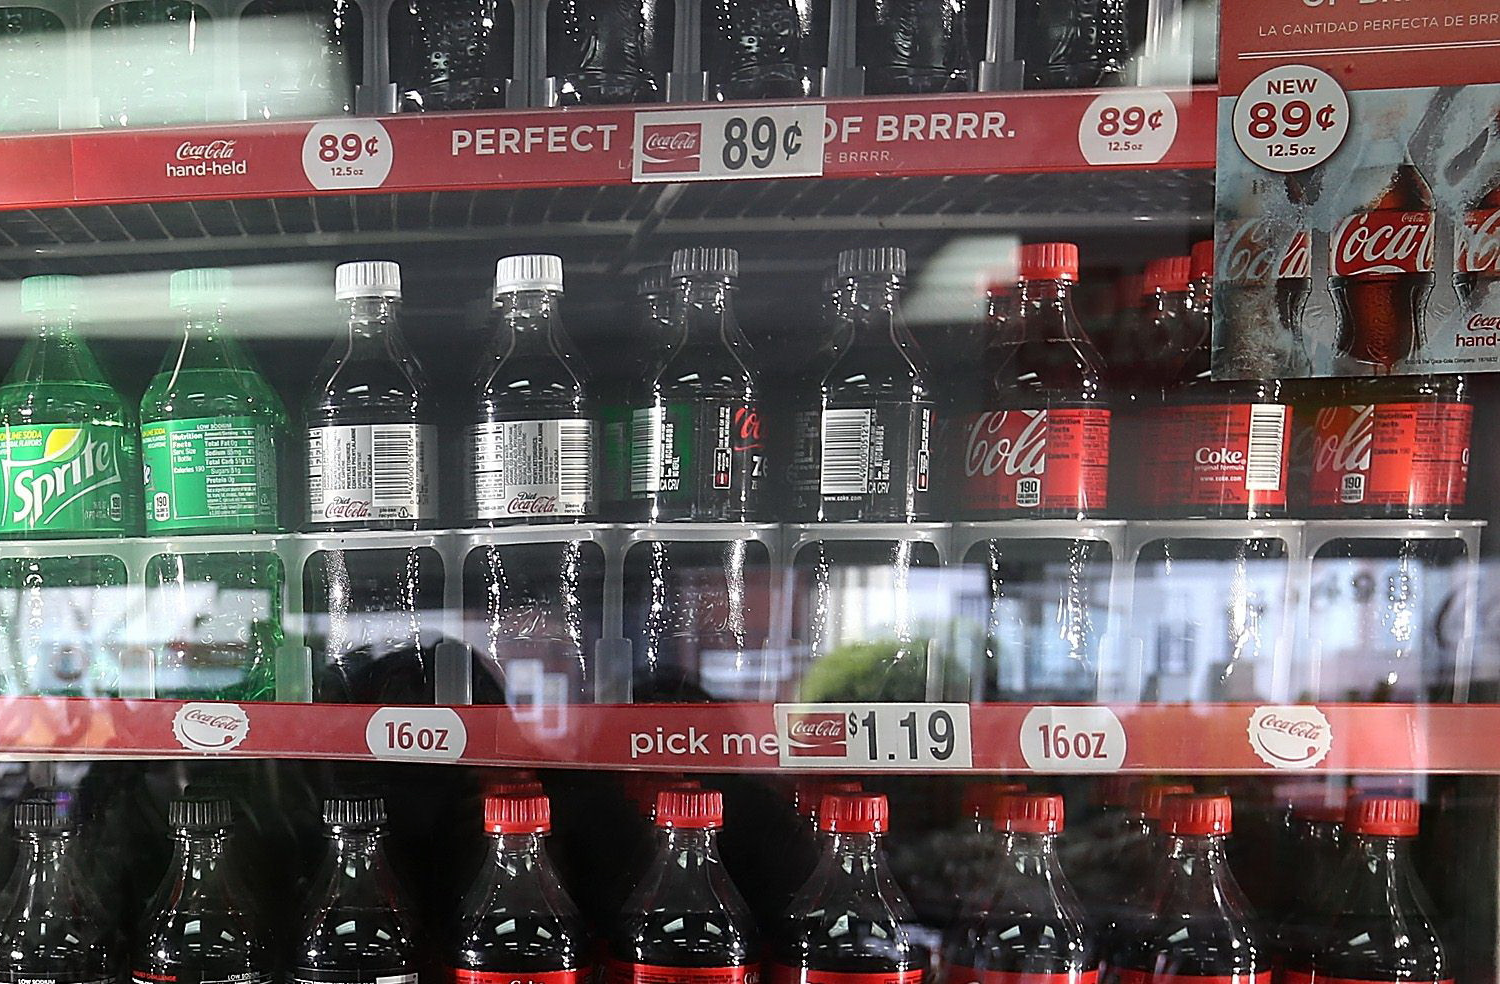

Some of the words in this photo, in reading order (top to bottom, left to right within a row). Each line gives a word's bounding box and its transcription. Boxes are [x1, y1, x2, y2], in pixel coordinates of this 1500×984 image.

[1259, 24, 1278, 37] LA
[1282, 21, 1359, 36] CANTIDAD
[1363, 17, 1439, 32] PERFECTA
[1444, 16, 1464, 27] DE
[1267, 78, 1318, 95] NEW
[1097, 106, 1164, 137] 89¢
[1248, 102, 1336, 139] 89¢
[452, 125, 618, 156] PERFECT
[876, 111, 1016, 141] BRRRR.
[722, 115, 803, 171] 89¢
[176, 139, 237, 161] Coca-Cola
[318, 133, 379, 163] 89¢
[166, 160, 247, 177] hand-held
[172, 433, 203, 441] Nutrition
[1195, 447, 1243, 464] Coke
[12, 439, 112, 528] Sprite
[1019, 481, 1038, 493] 190
[1344, 476, 1361, 489] 190
[156, 496, 168, 508] 190
[325, 501, 370, 519] Coca-Cola
[507, 496, 556, 514] Coca-Cola
[183, 708, 241, 733] Coca-Cola
[1259, 713, 1322, 740] Coca-Cola
[630, 727, 709, 757] pick
[722, 732, 779, 757] me
[848, 711, 956, 763] $1.19
